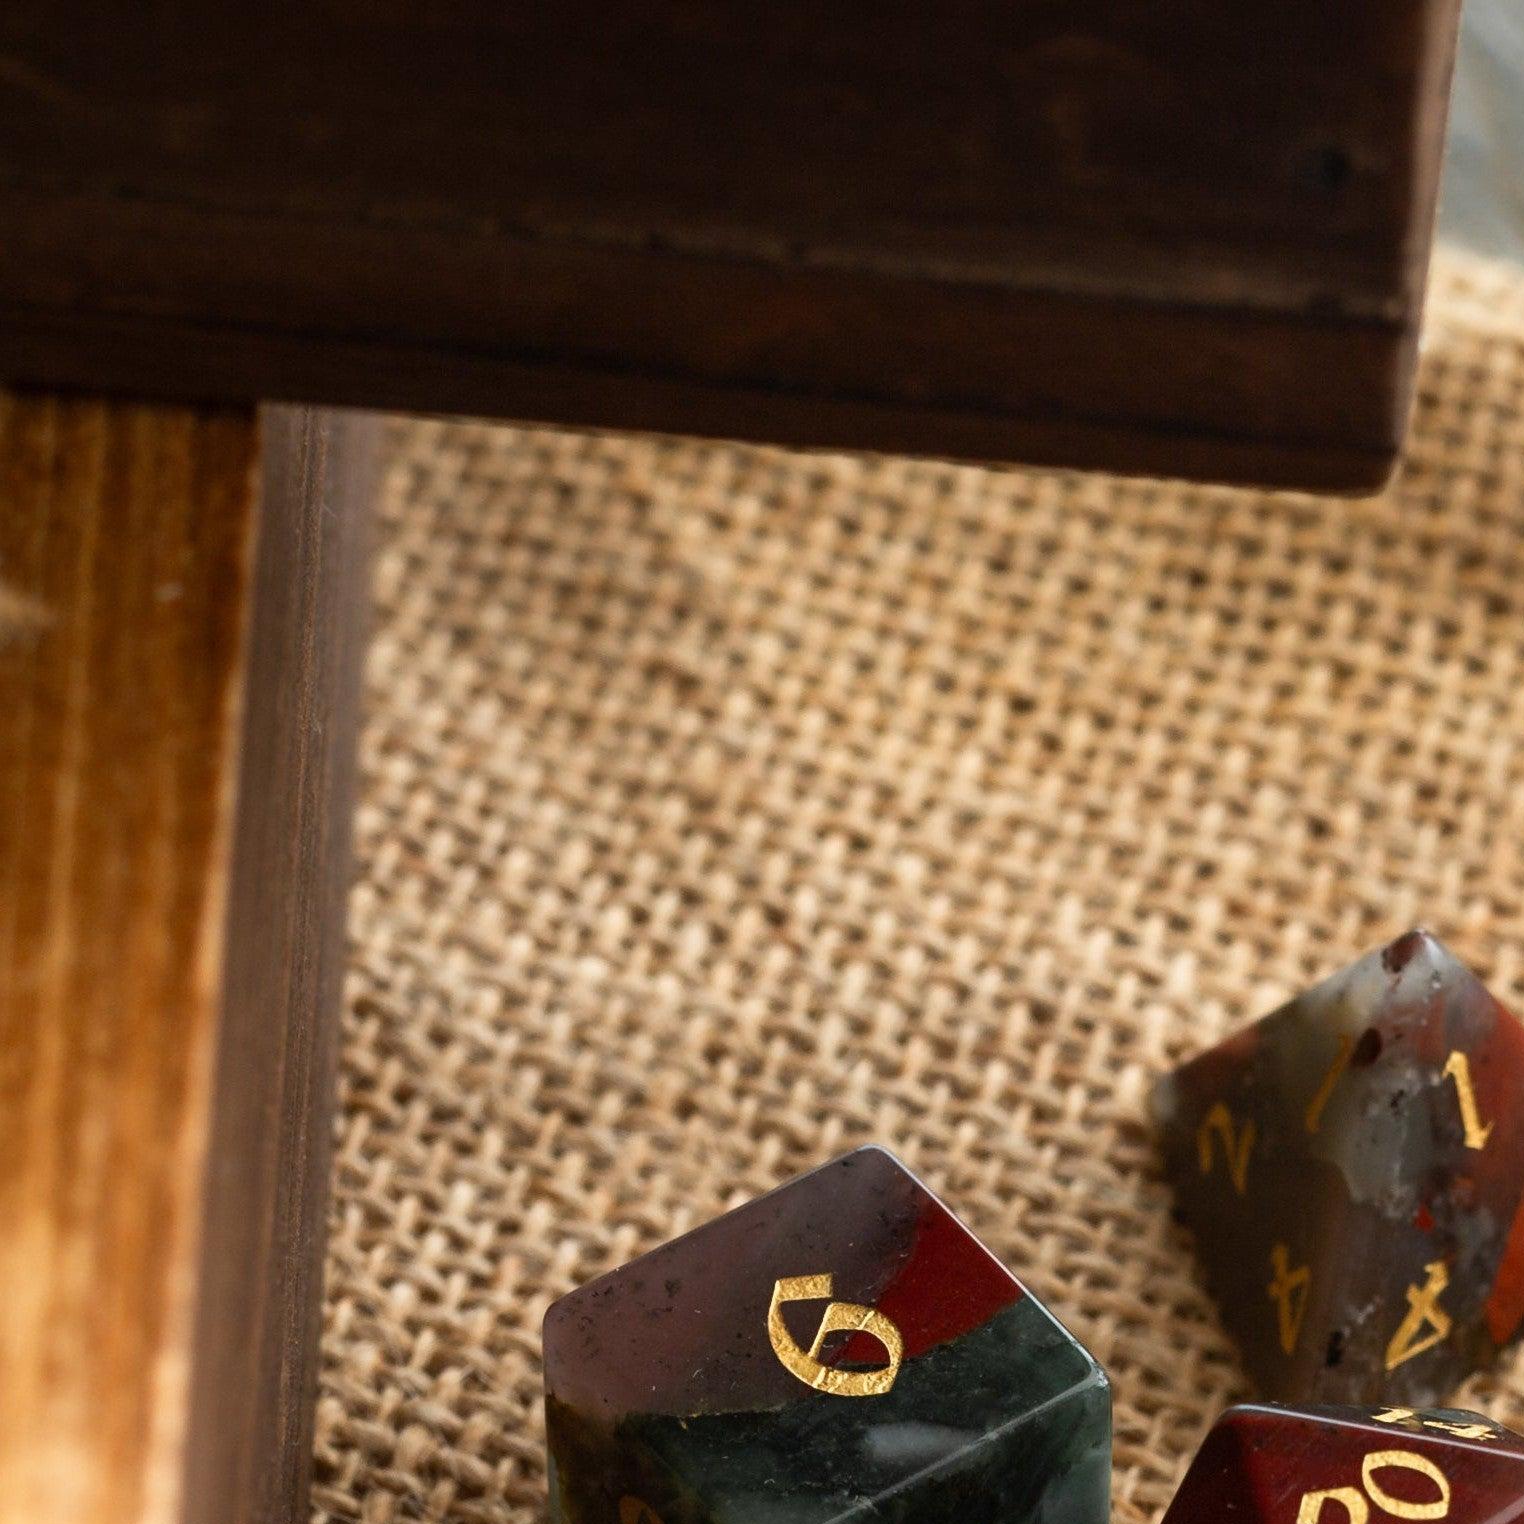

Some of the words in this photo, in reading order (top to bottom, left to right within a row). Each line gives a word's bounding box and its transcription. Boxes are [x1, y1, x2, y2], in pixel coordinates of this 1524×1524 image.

[1443, 1050, 1494, 1149] 1
[768, 1272, 903, 1397] 6
[1385, 1260, 1450, 1370] 4
